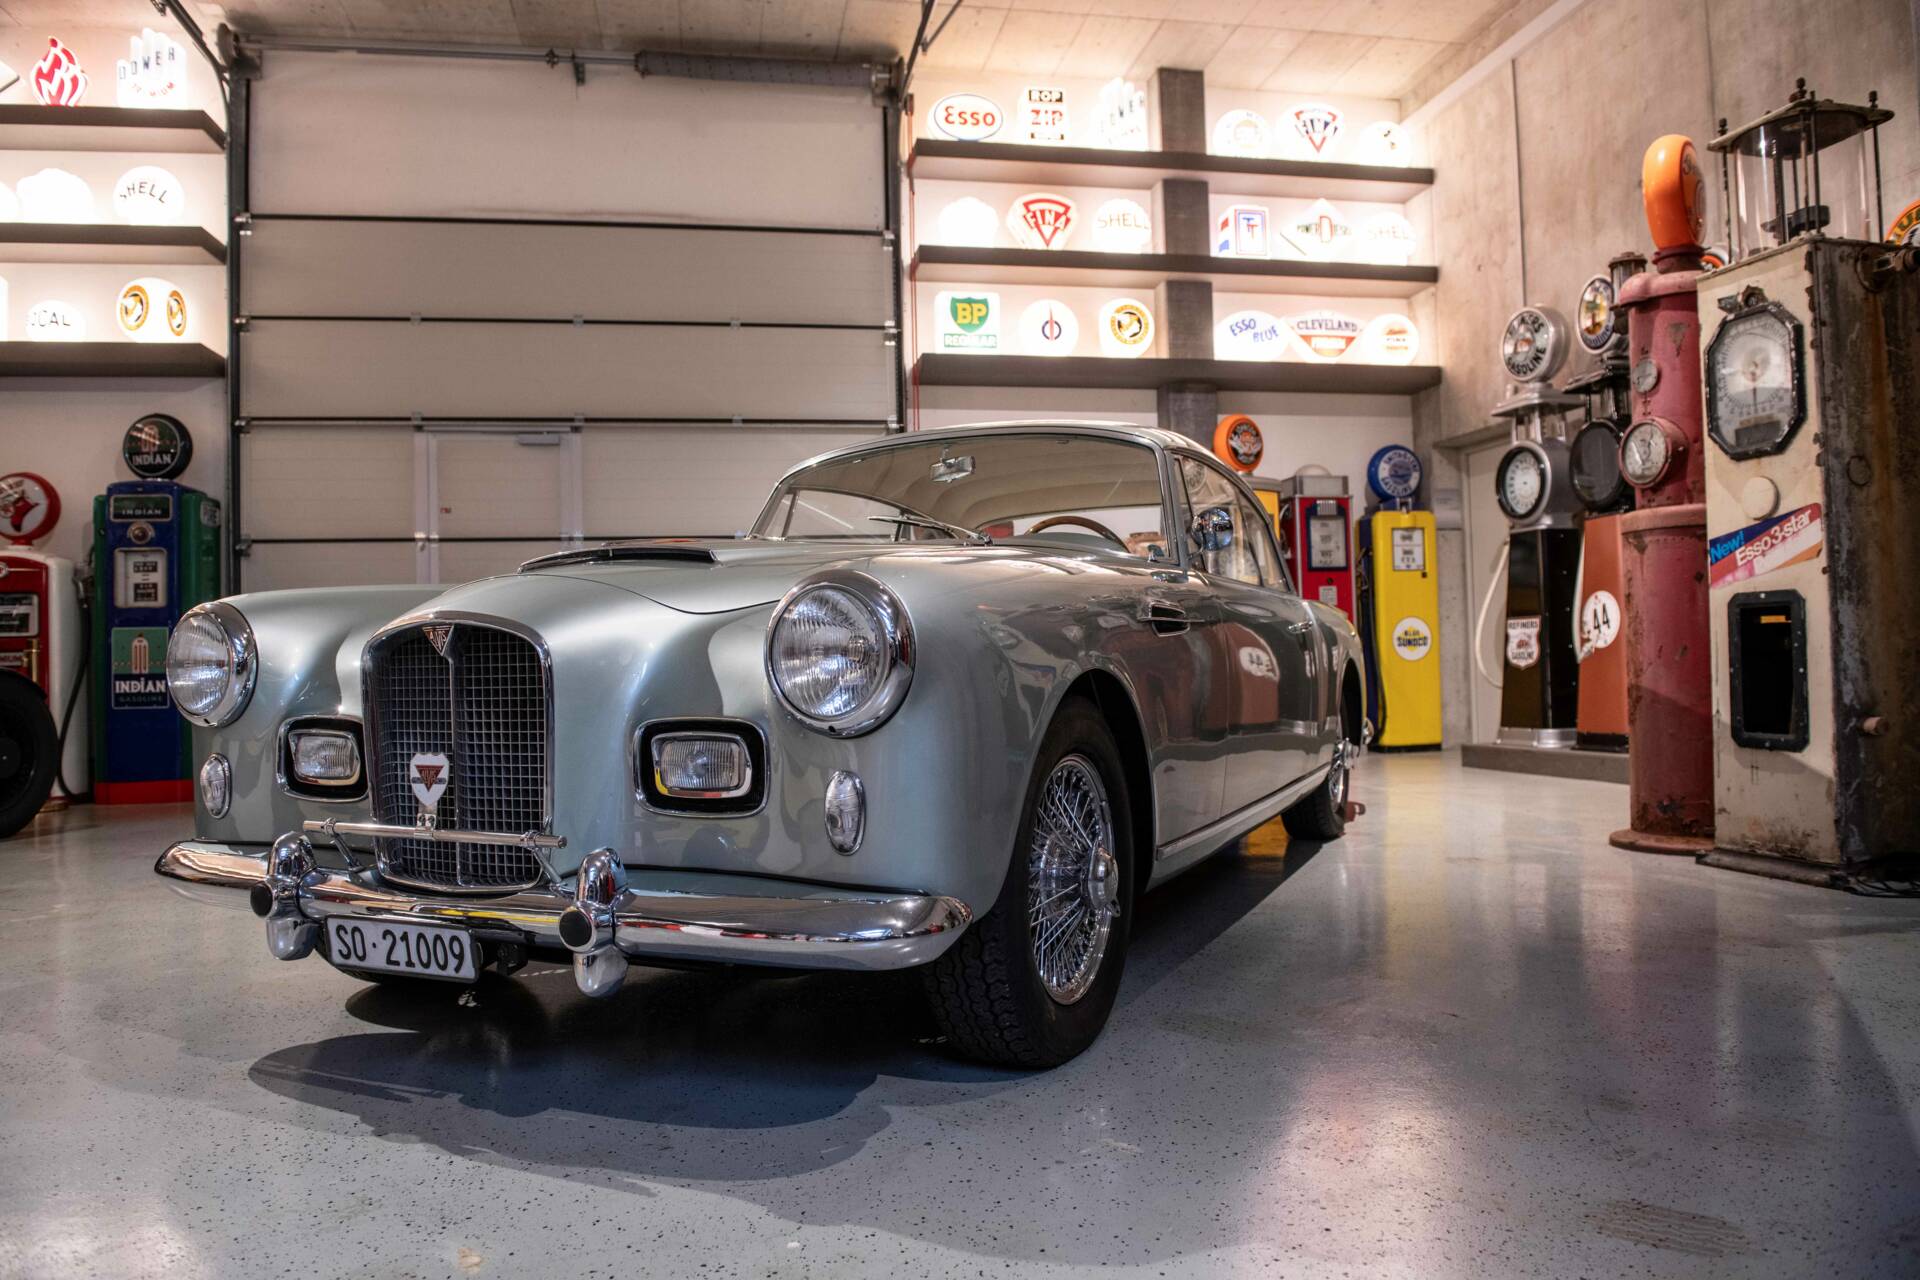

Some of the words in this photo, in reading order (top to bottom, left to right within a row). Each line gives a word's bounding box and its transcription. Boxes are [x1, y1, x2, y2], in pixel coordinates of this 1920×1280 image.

[1023, 208, 1070, 231] FINA
[957, 303, 987, 325] BP
[1229, 318, 1257, 336] ESSO
[1253, 325, 1279, 343] BLUE
[1296, 318, 1358, 333] CLEVELAND
[132, 453, 172, 465] INDIAN
[1710, 530, 1745, 565] New!
[1735, 535, 1772, 567] Esso
[1593, 603, 1611, 634] 44
[1397, 636, 1428, 647] SUNOCO
[115, 676, 166, 694] INDIAN
